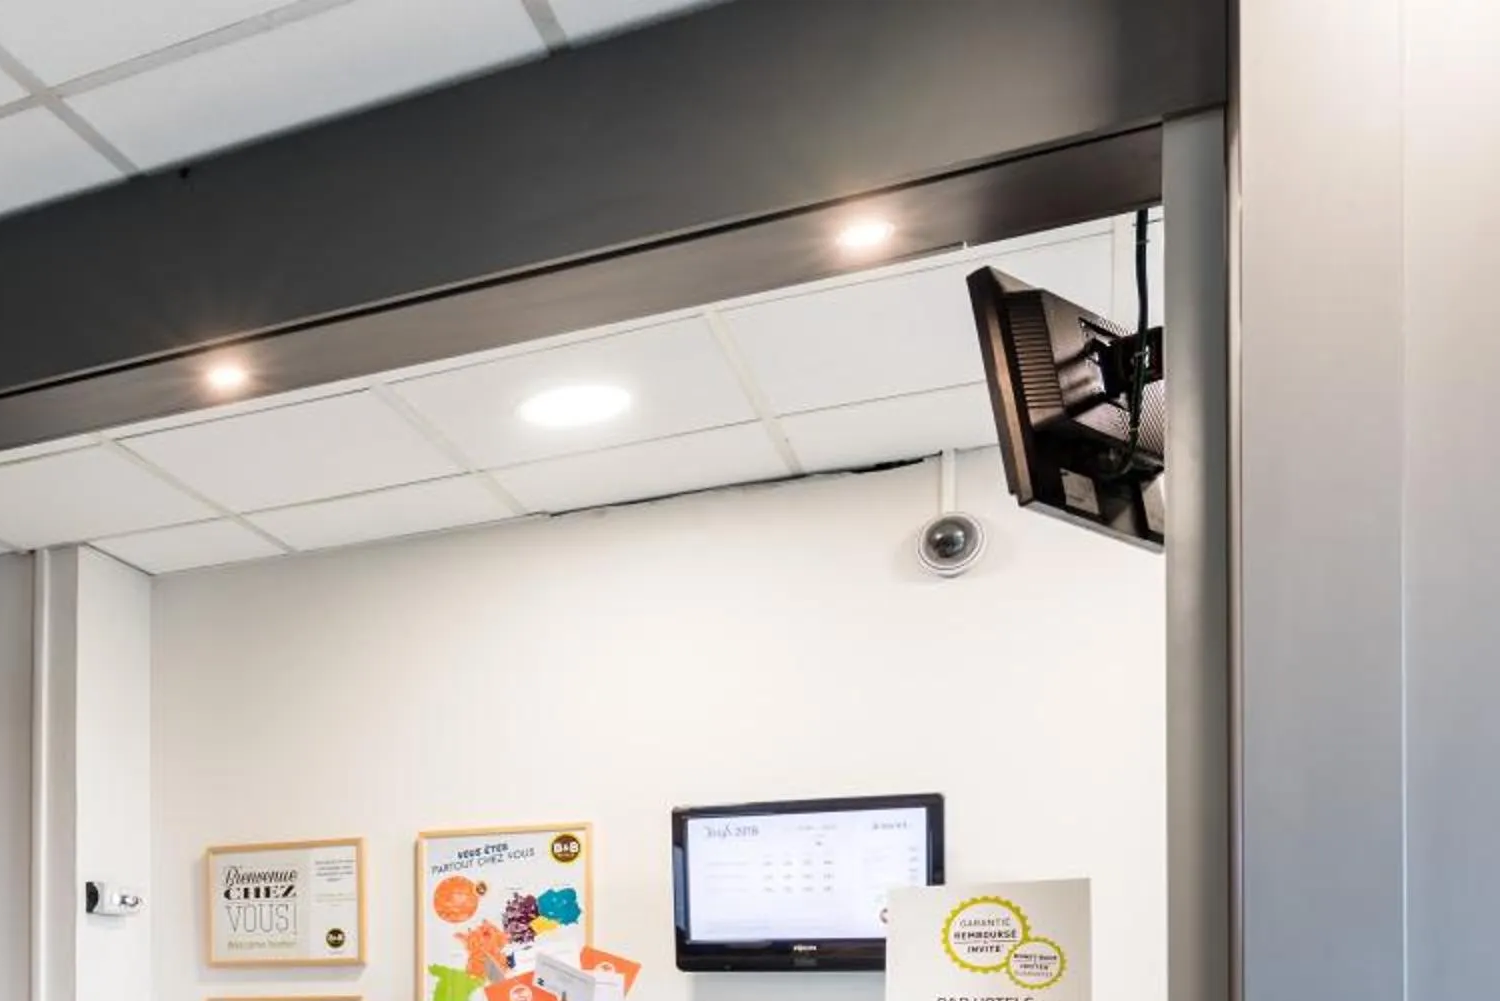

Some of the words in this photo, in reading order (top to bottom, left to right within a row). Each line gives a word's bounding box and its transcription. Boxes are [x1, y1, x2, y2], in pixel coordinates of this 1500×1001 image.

[430, 858, 473, 874] PARTOUT
[477, 854, 504, 867] CHEZ
[508, 847, 535, 859] VOUS
[225, 865, 298, 886] Bienvenue
[223, 885, 297, 900] CHEZ
[954, 929, 1016, 939] REMBOURSÉ
